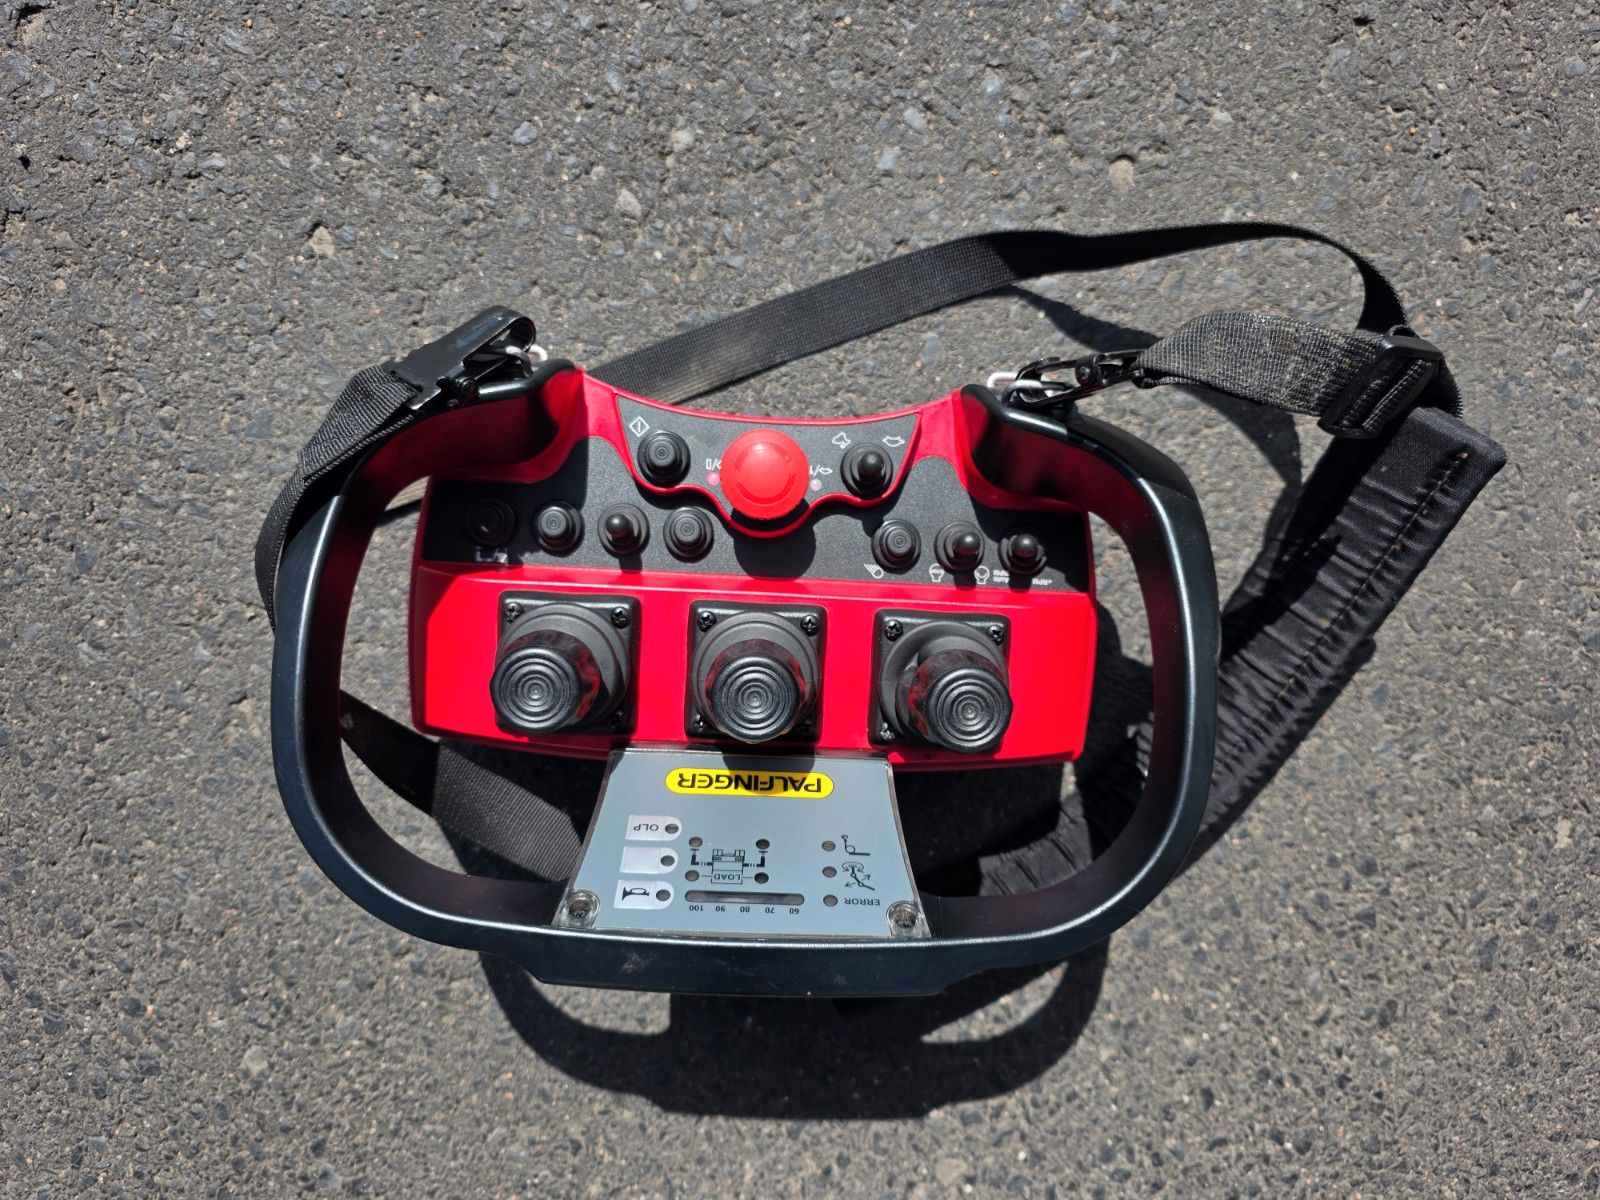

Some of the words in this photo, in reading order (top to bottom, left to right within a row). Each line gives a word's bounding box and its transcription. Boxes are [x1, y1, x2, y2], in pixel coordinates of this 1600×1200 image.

[677, 773, 822, 793] PALFINGER
[633, 822, 660, 832] OLP
[713, 872, 741, 882] LOAD
[844, 897, 881, 906] ERROR
[688, 903, 705, 912] 100
[715, 904, 726, 913] 90
[739, 905, 751, 913] 80
[764, 906, 776, 914] 70
[788, 907, 800, 915] 60
